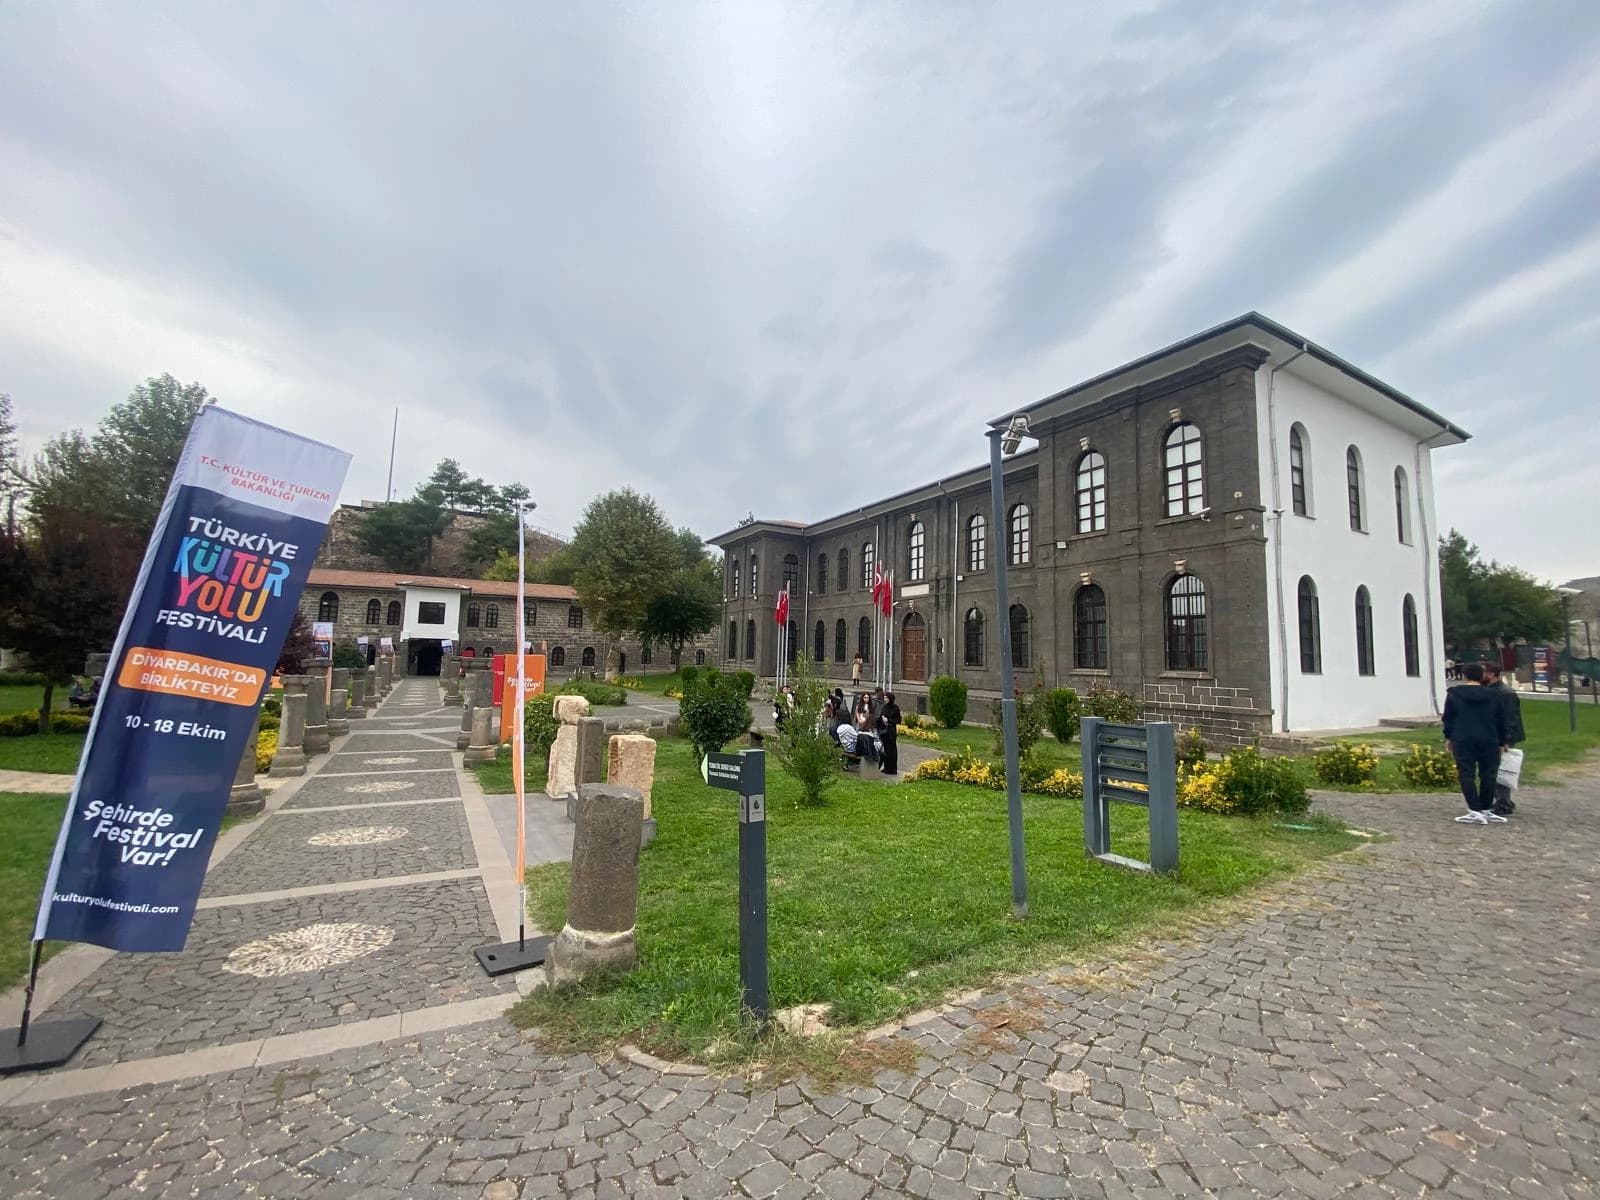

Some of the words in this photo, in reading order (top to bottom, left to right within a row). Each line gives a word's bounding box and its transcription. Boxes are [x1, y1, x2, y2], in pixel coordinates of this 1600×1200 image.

[200, 455, 221, 469] T.C.
[222, 463, 269, 485] KÜLTÜR
[271, 479, 287, 490] VE
[288, 483, 330, 502] TURİZM
[230, 477, 295, 503] BAKANLIĞI
[189, 516, 299, 560] TÜRKİYE
[173, 536, 290, 597] KÜLTÜR
[176, 574, 270, 623] YOLU
[156, 609, 268, 644] FESTİVALİ
[132, 653, 257, 685] DİYARBAKIR'DA
[140, 671, 240, 699] BİRLİKTEYİZ
[124, 714, 142, 729] 10
[153, 718, 173, 734] 18
[176, 721, 227, 741] Ekim
[83, 799, 174, 828] Şehirde
[92, 819, 204, 849] Festival
[120, 845, 178, 867] Var!
[51, 891, 180, 914] kulturyolufestivali.com
